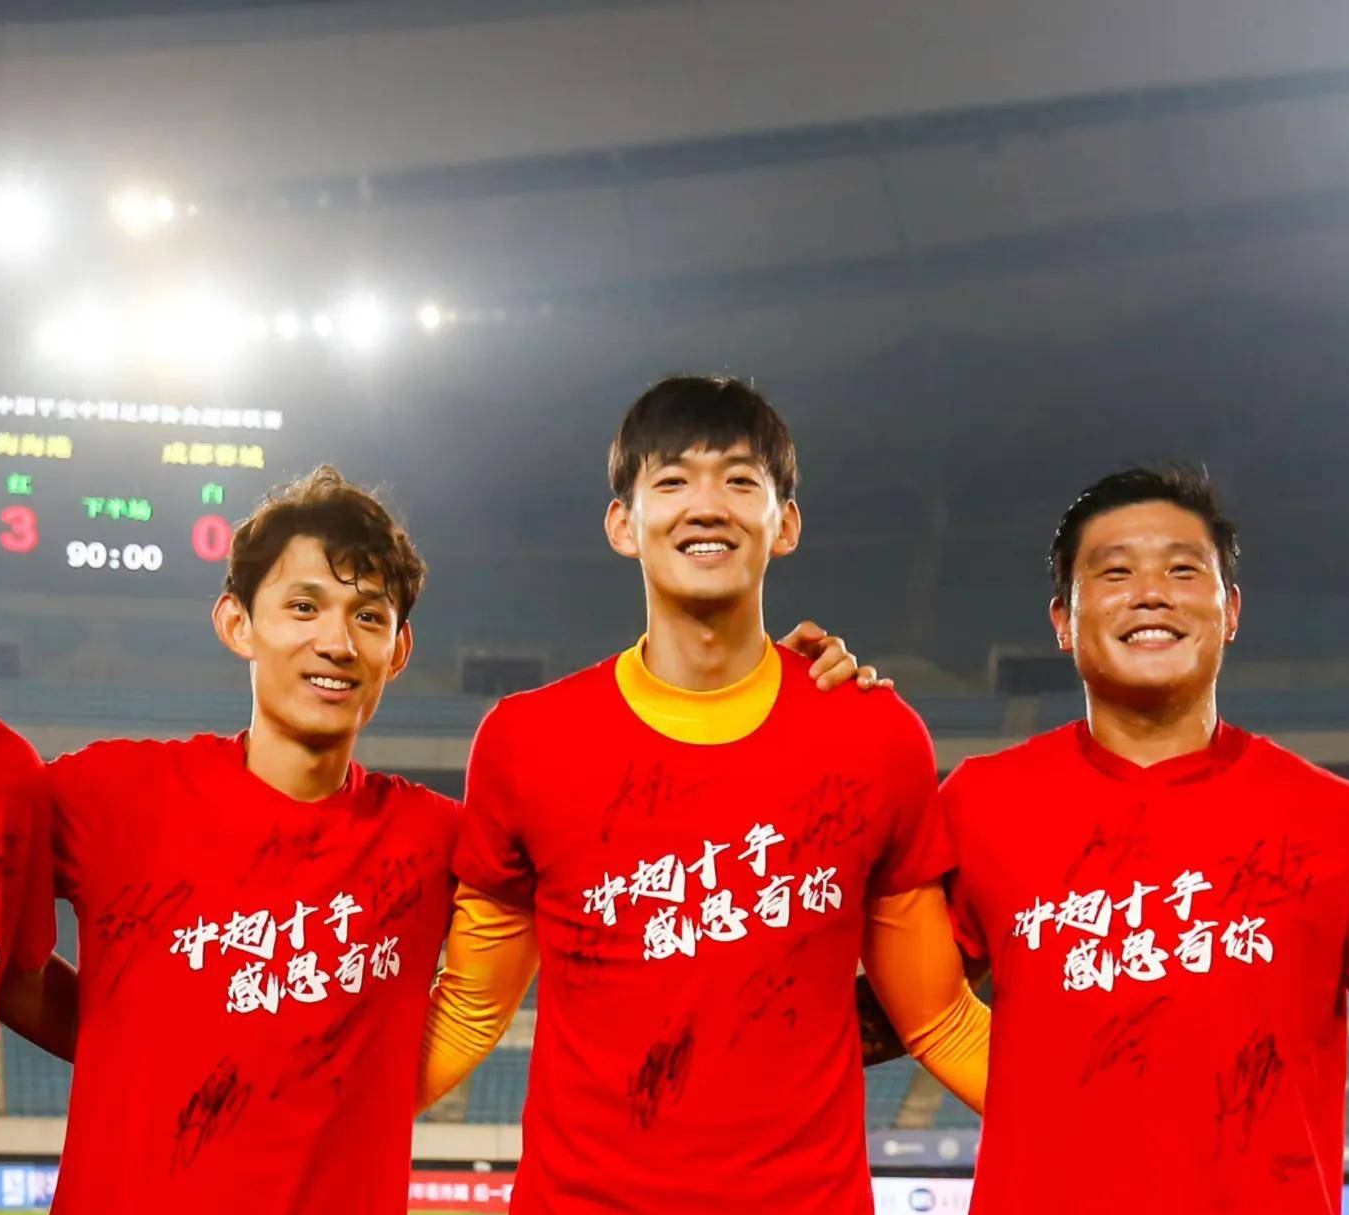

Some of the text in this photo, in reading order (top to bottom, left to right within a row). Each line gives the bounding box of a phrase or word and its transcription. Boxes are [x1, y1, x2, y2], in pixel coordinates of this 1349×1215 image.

[65, 539, 164, 572] 90:00
[190, 512, 234, 562] 0
[582, 823, 785, 927] 冲超十年
[643, 866, 843, 961] 感恩有你
[1012, 869, 1213, 950] 冲超十年
[169, 891, 363, 970] 冲超十年
[1063, 915, 1274, 992] 感恩有你
[226, 936, 400, 1014] 感恩有你
